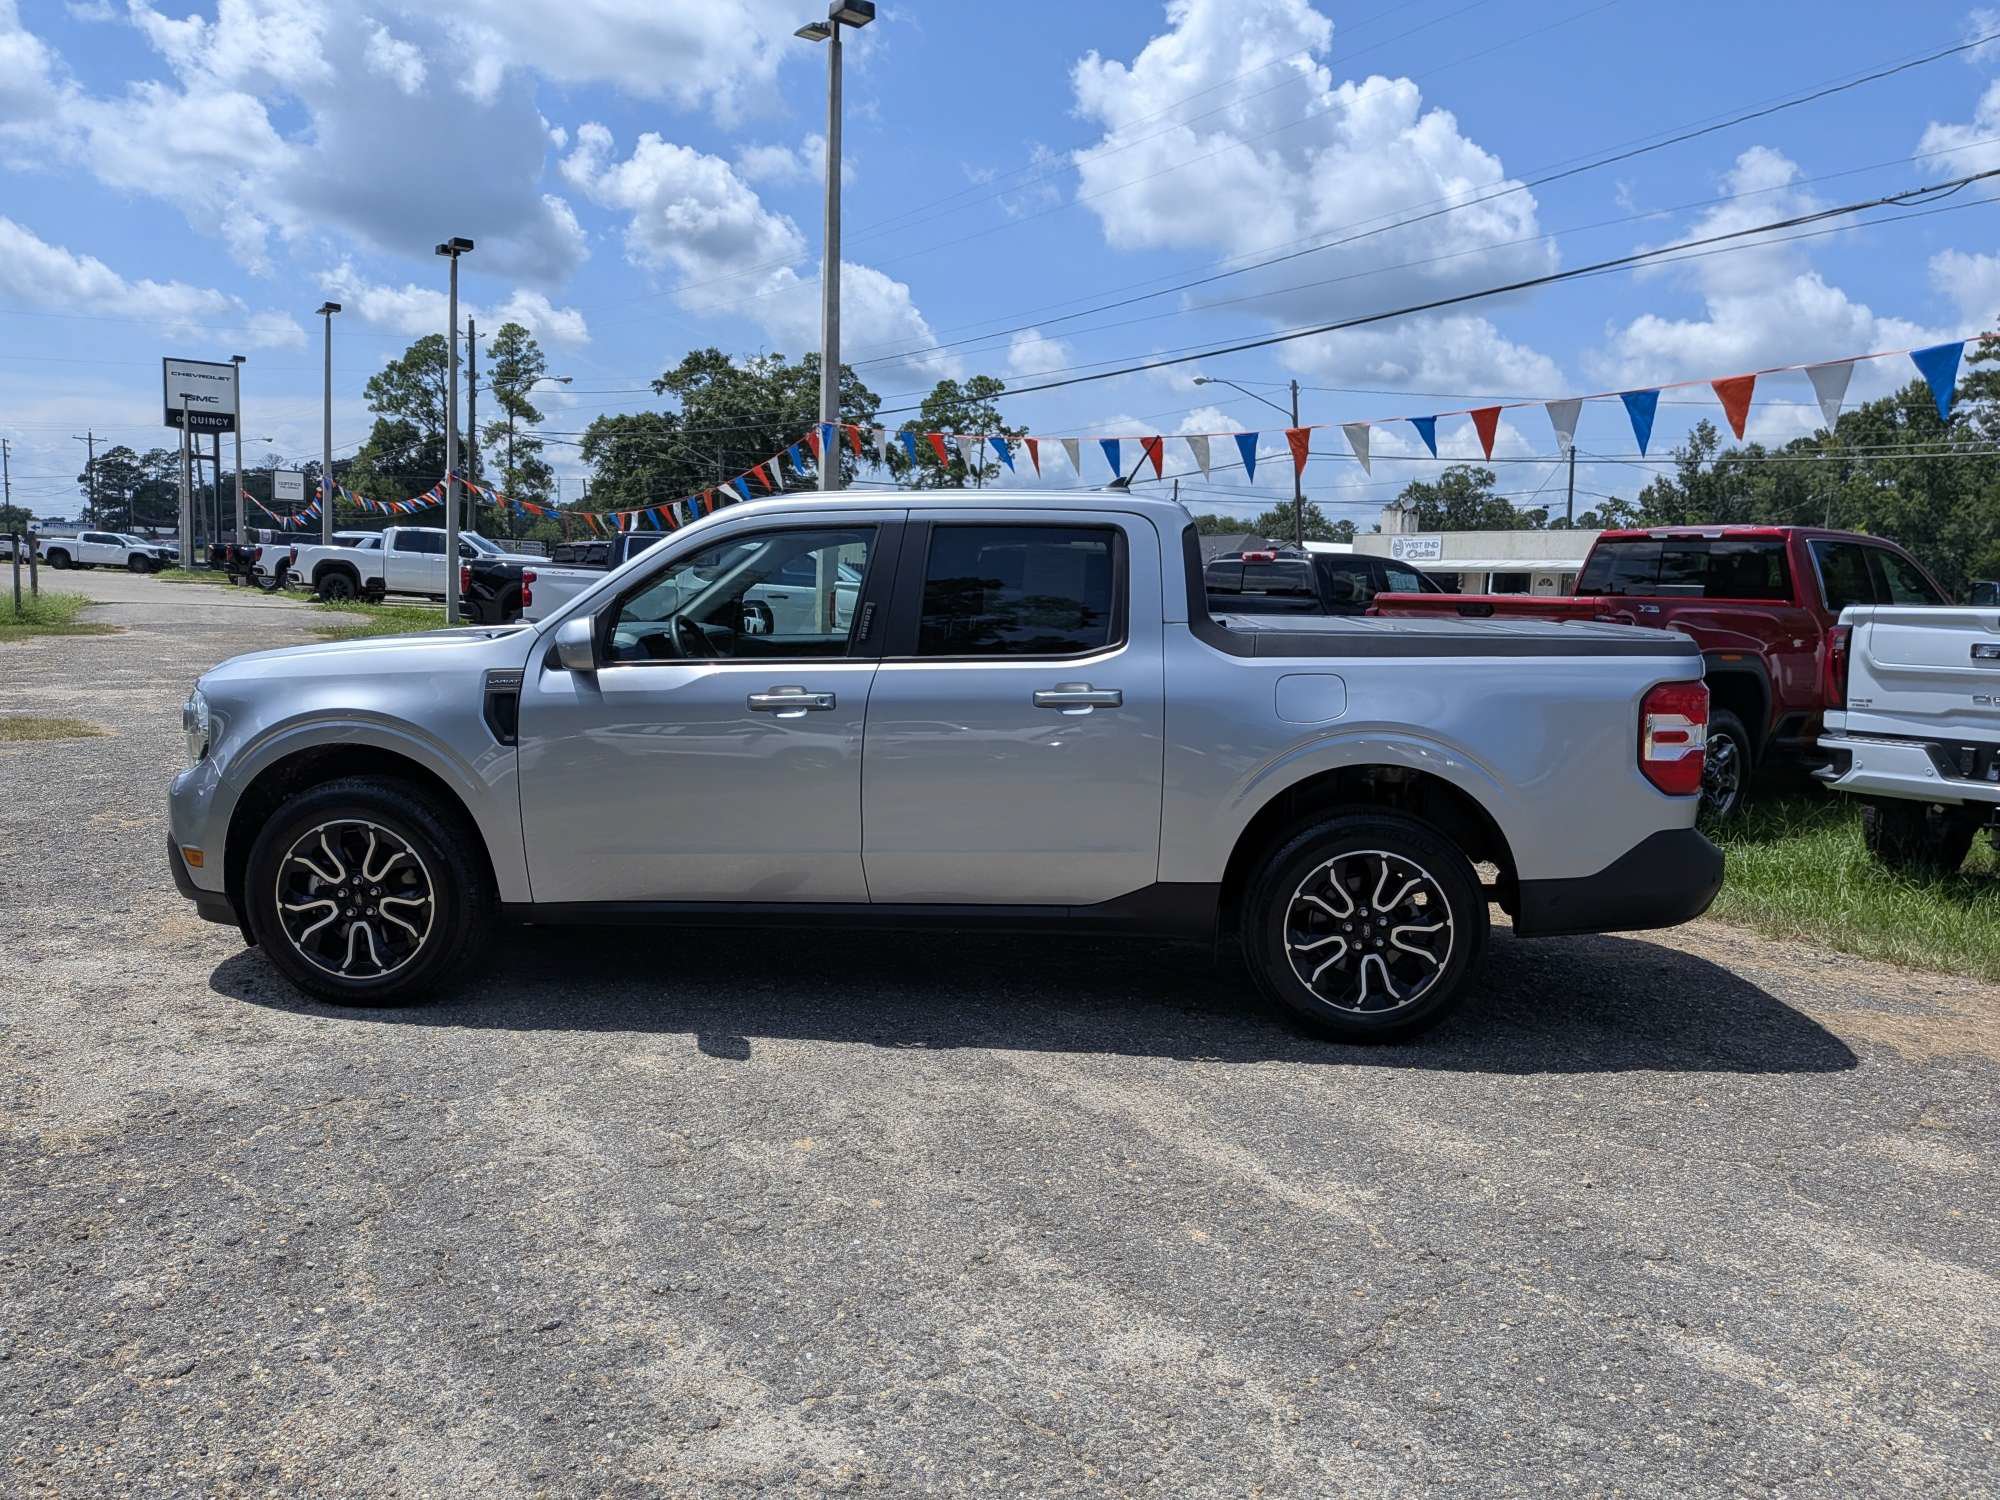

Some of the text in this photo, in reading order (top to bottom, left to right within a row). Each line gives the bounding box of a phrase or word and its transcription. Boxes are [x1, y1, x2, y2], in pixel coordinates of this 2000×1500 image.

[170, 371, 231, 381] CHEVROLET
[190, 416, 229, 426] QUINCY
[1404, 541, 1440, 549] WEST END
